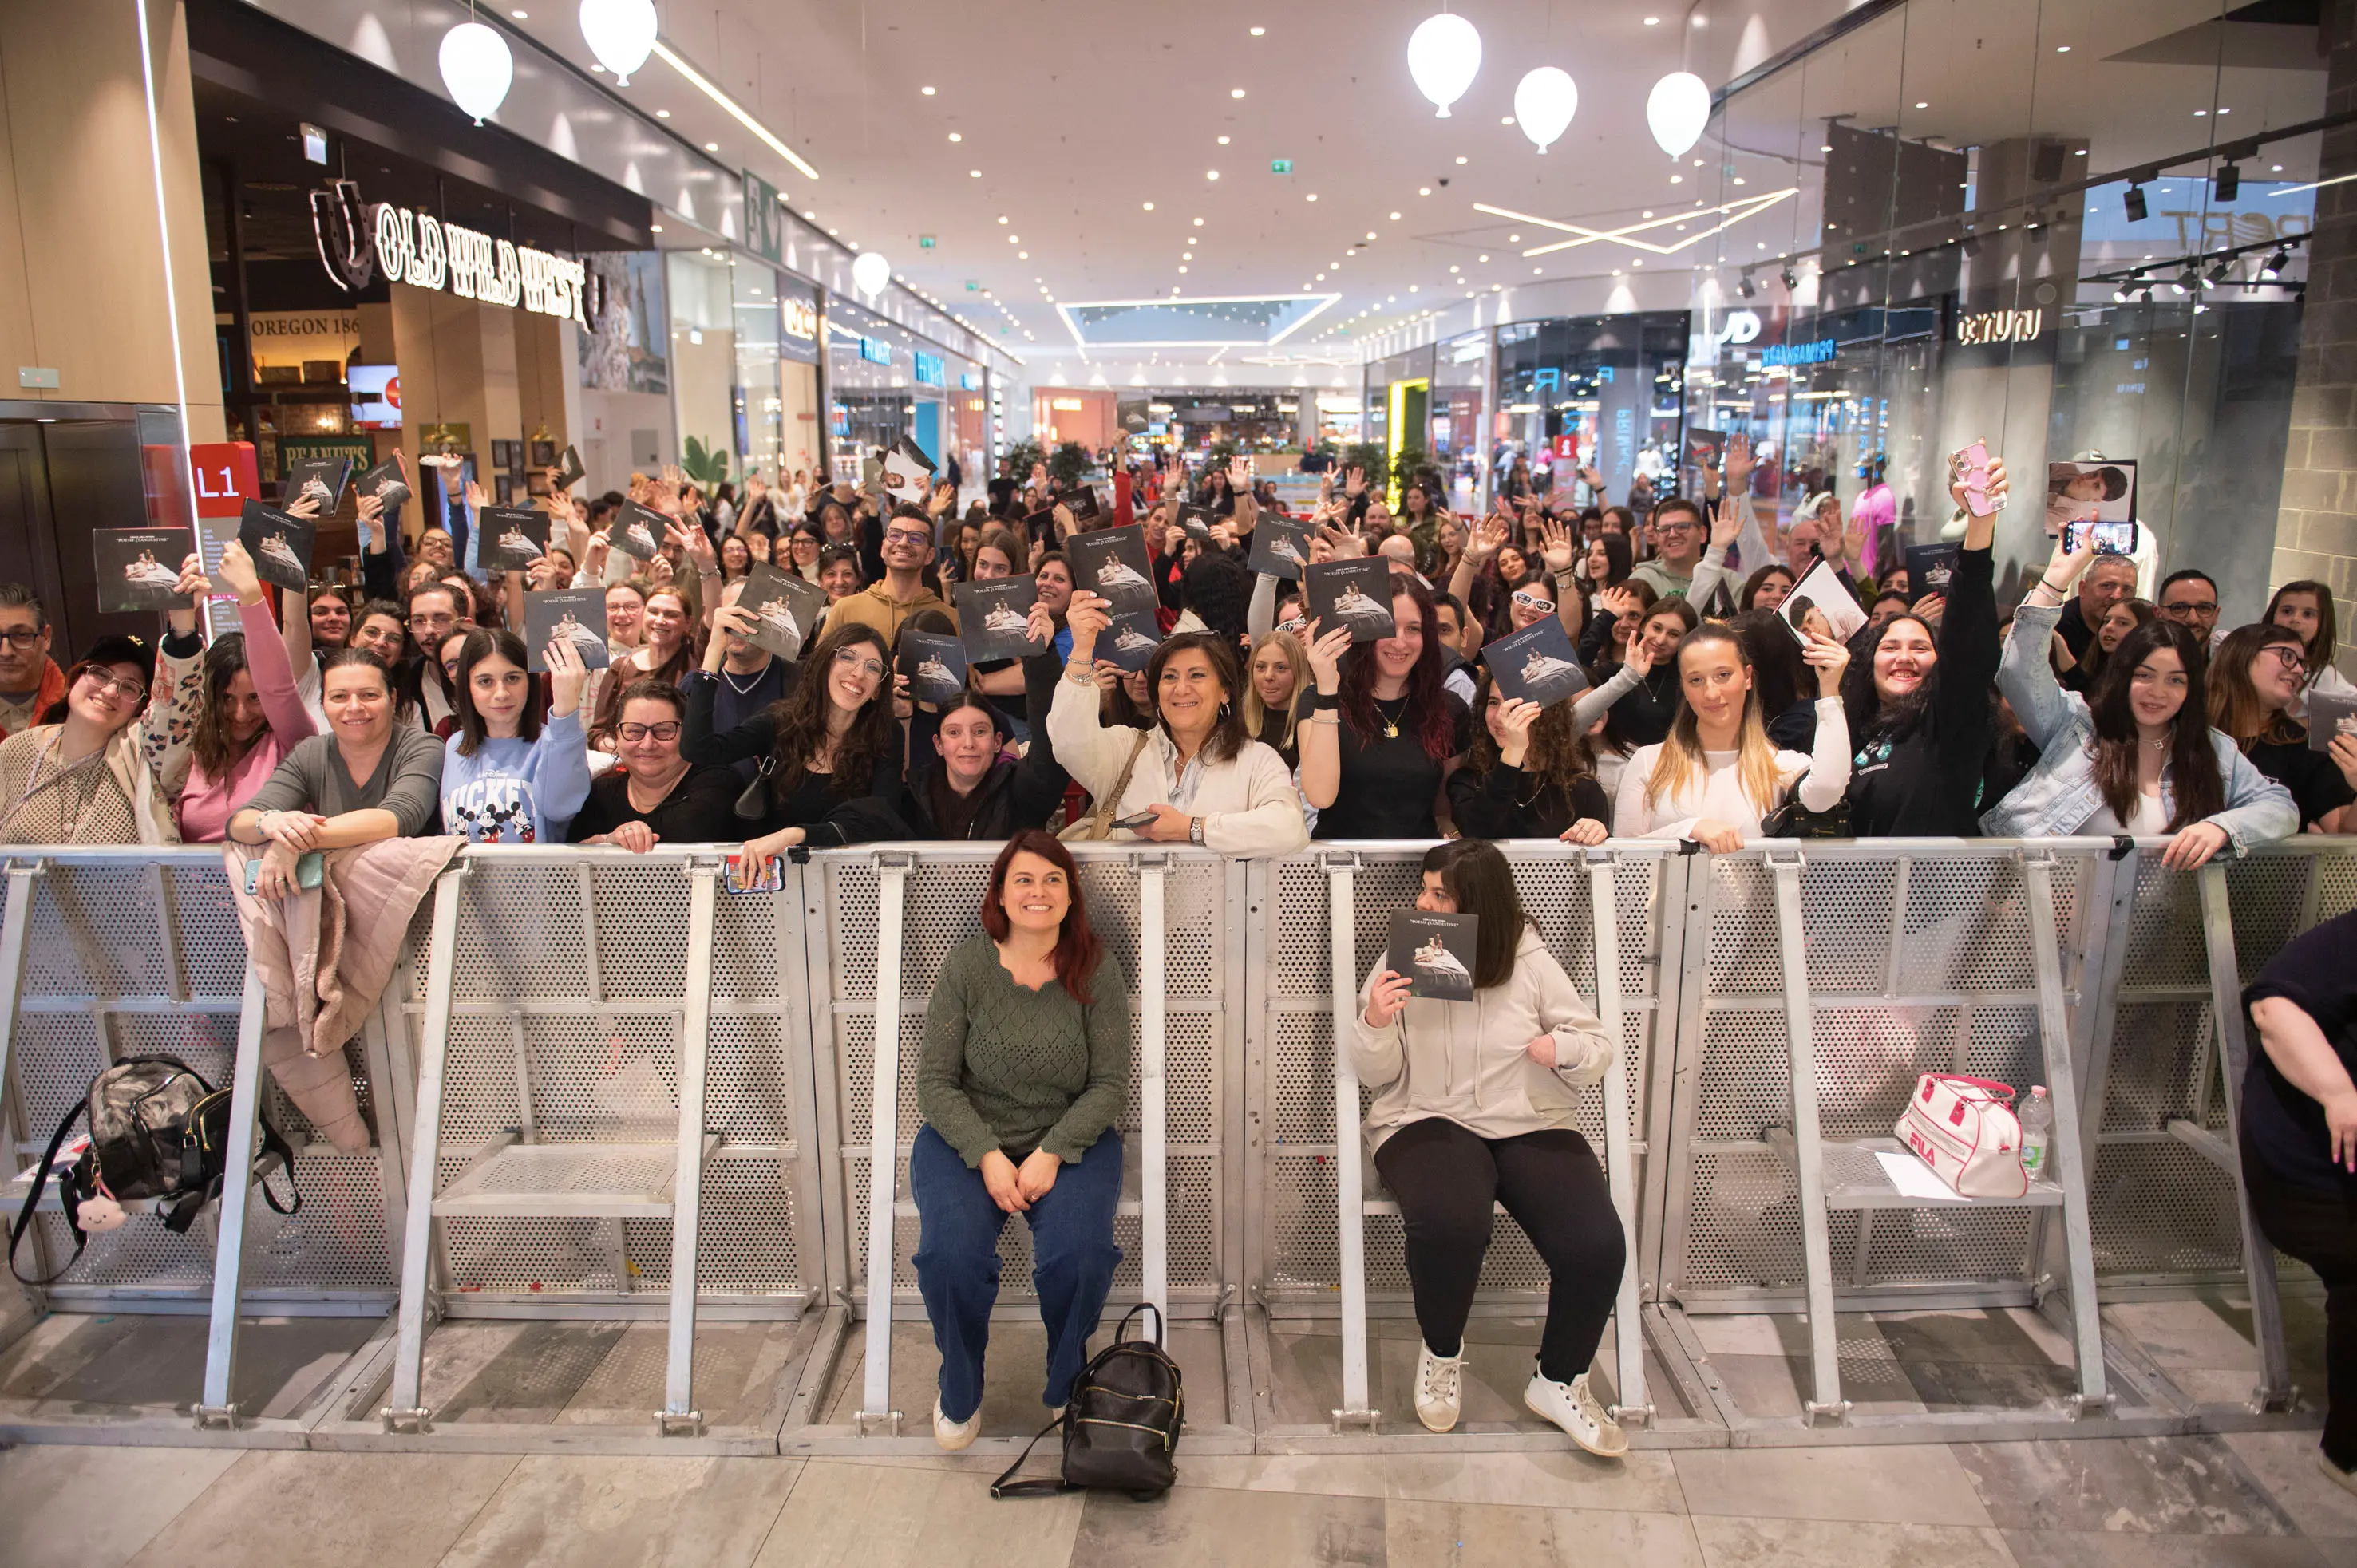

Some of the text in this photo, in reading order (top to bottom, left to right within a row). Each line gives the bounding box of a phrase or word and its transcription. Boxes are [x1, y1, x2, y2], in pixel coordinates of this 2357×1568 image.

[376, 203, 585, 322] OLD WILD WEST
[251, 319, 328, 337] OREGON
[197, 466, 239, 498] L1
[1910, 1132, 1935, 1167] FILA
